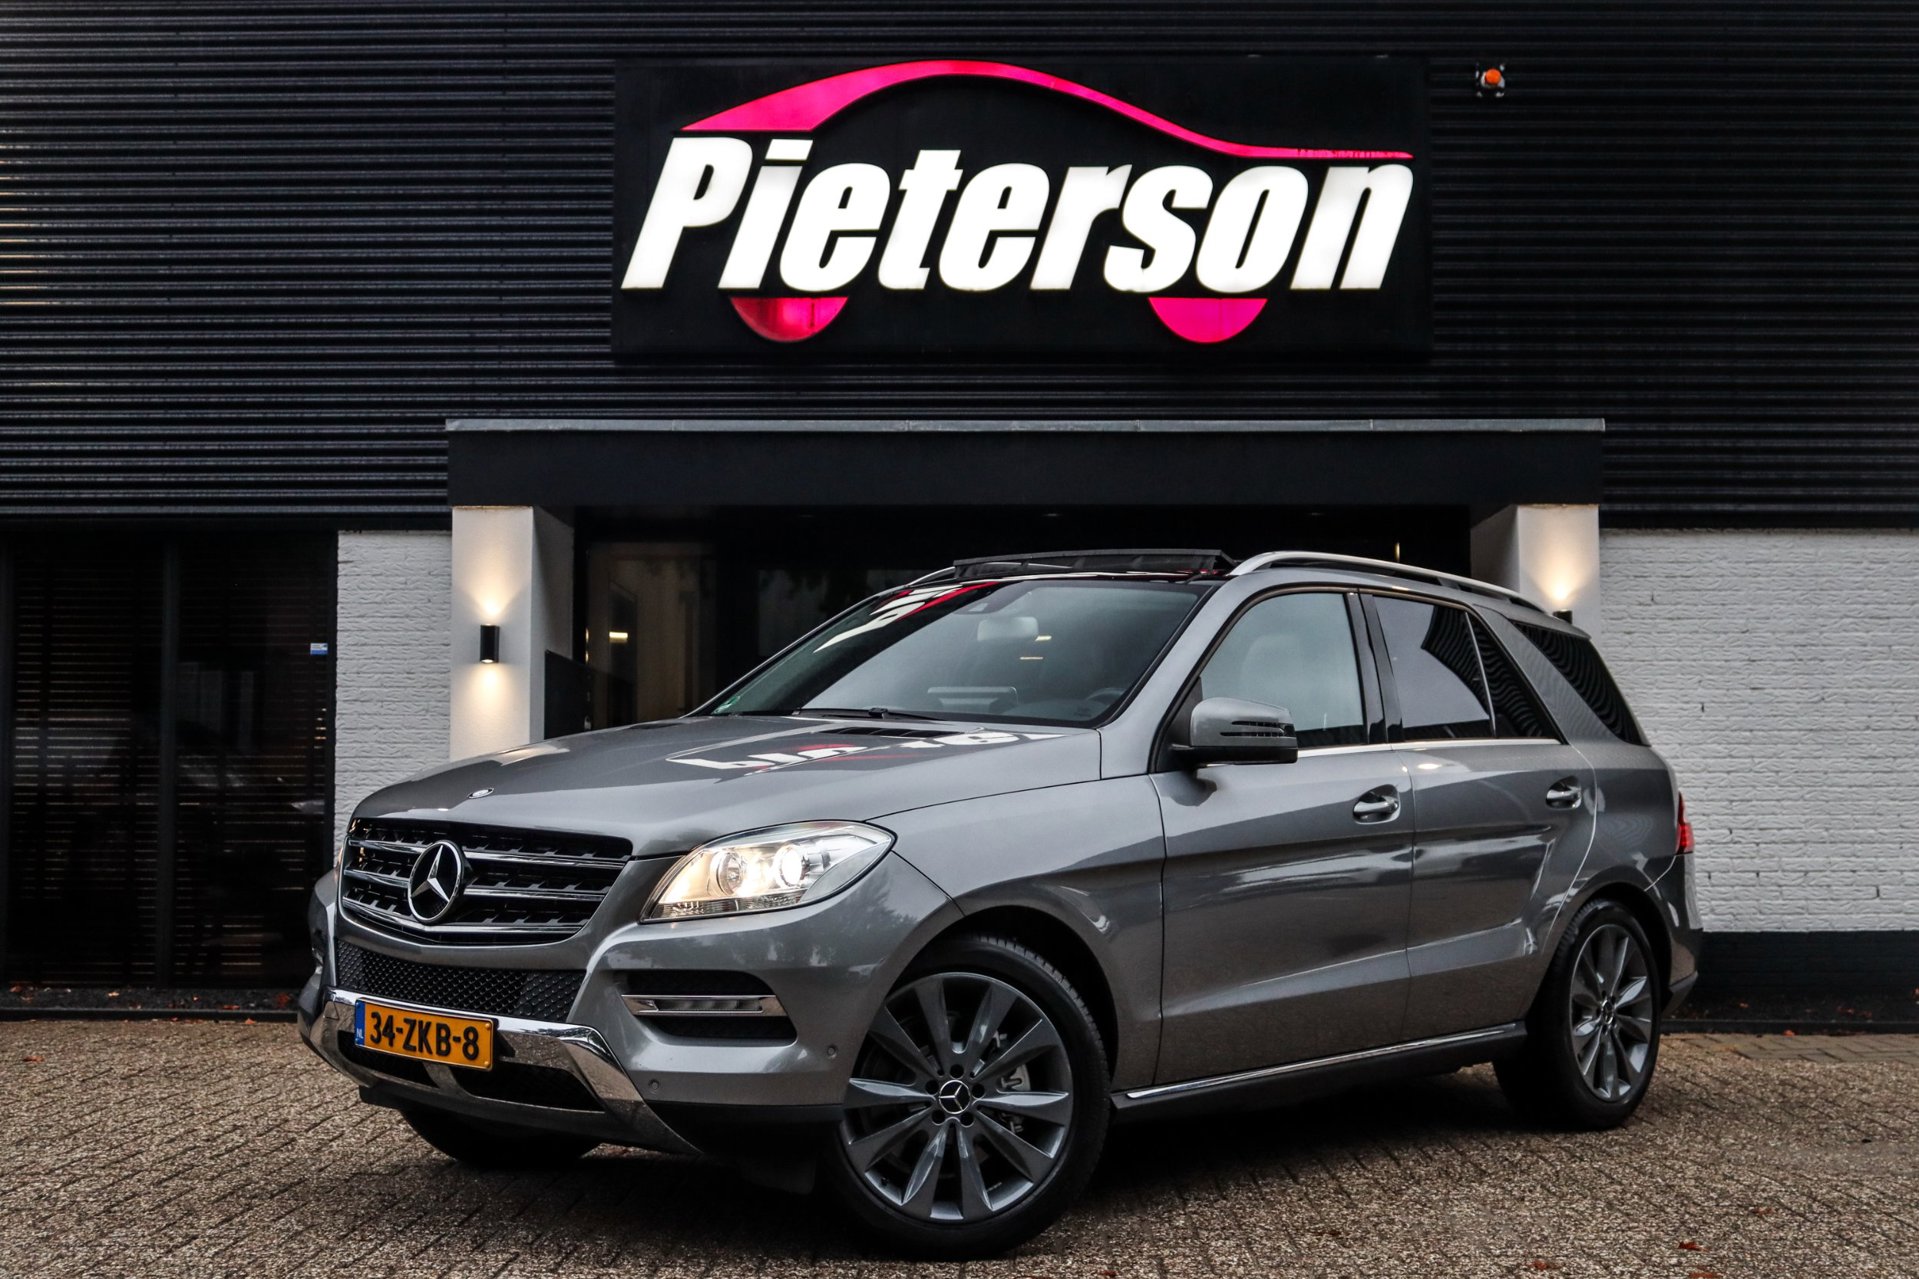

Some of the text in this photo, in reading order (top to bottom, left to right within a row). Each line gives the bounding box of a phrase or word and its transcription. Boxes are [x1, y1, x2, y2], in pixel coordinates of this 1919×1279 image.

[621, 136, 1414, 292] Pieterson
[355, 1027, 364, 1039] NL
[369, 1011, 480, 1061] 34-ZKB-8
